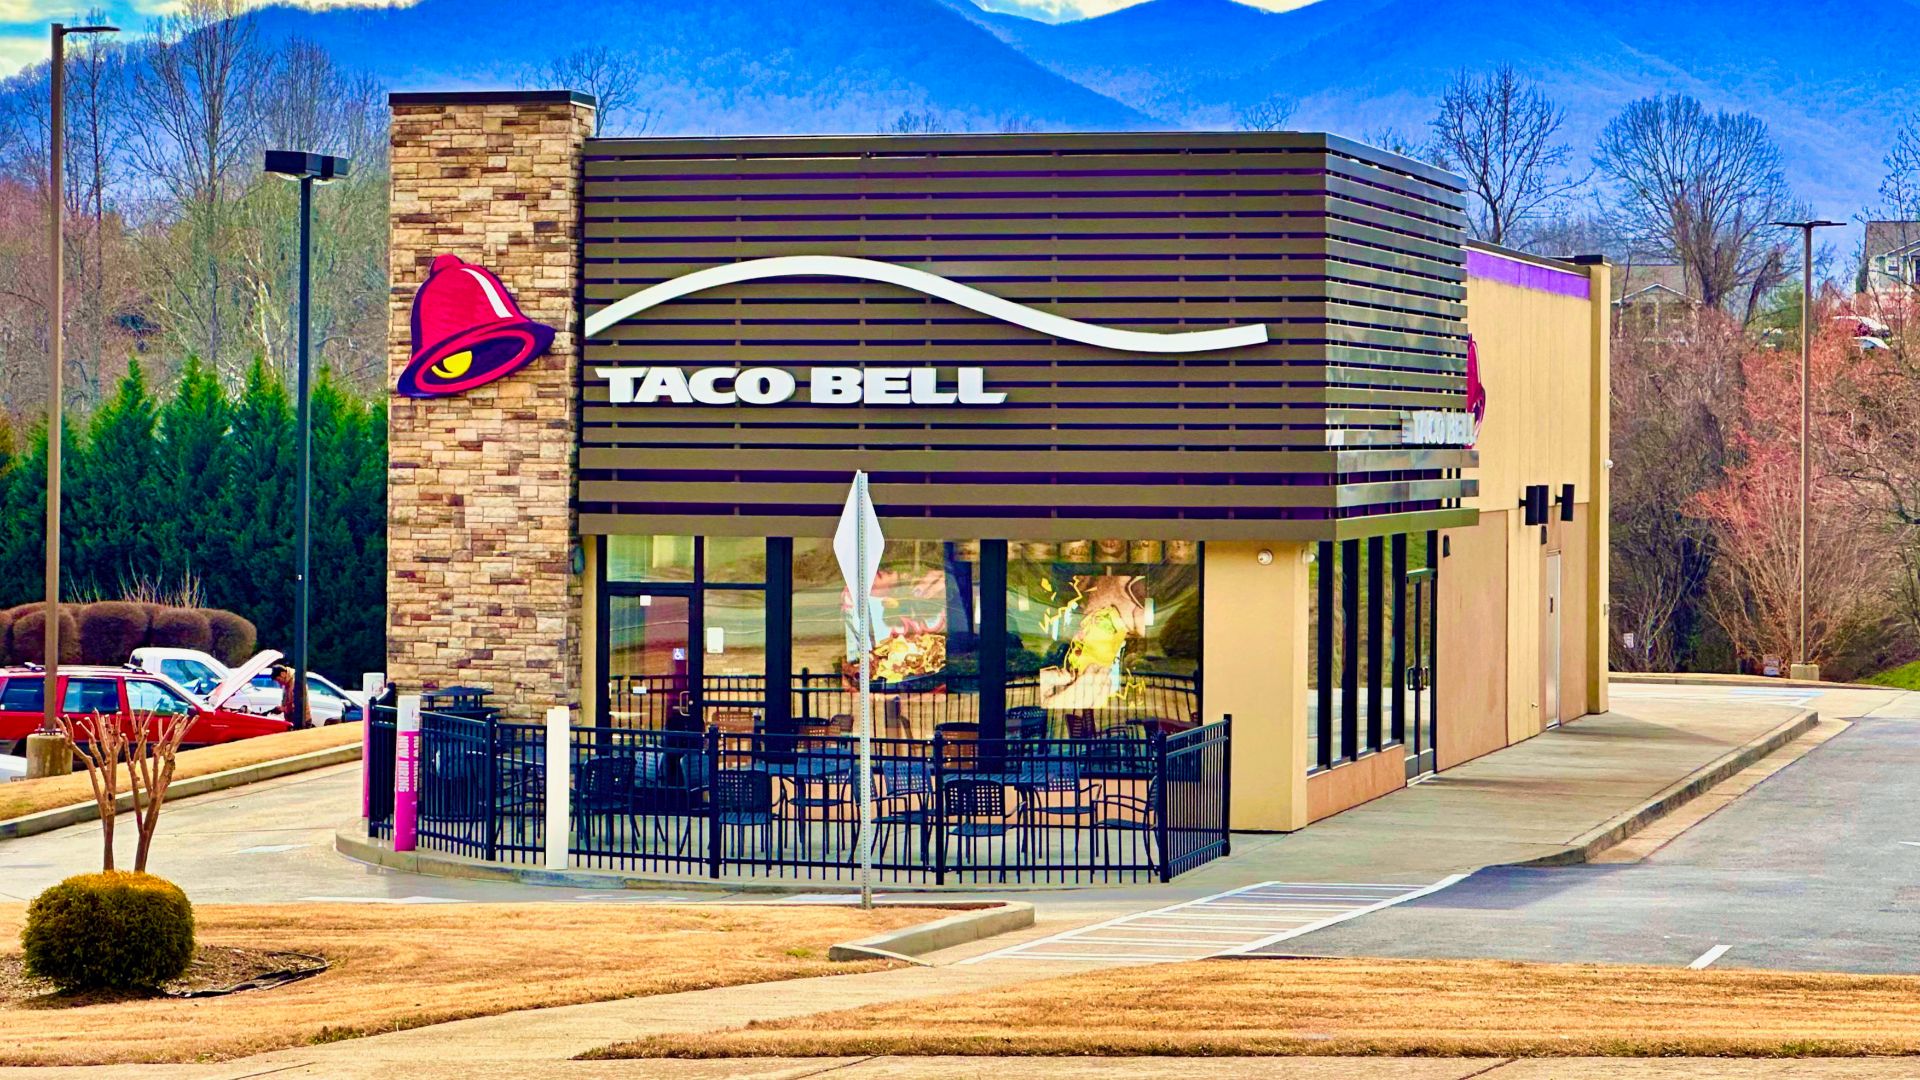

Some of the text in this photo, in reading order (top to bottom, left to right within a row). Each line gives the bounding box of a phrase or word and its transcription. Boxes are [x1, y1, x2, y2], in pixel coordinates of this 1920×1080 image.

[595, 367, 1008, 405] TACO BELL
[398, 736, 409, 792] NOW HIRING
